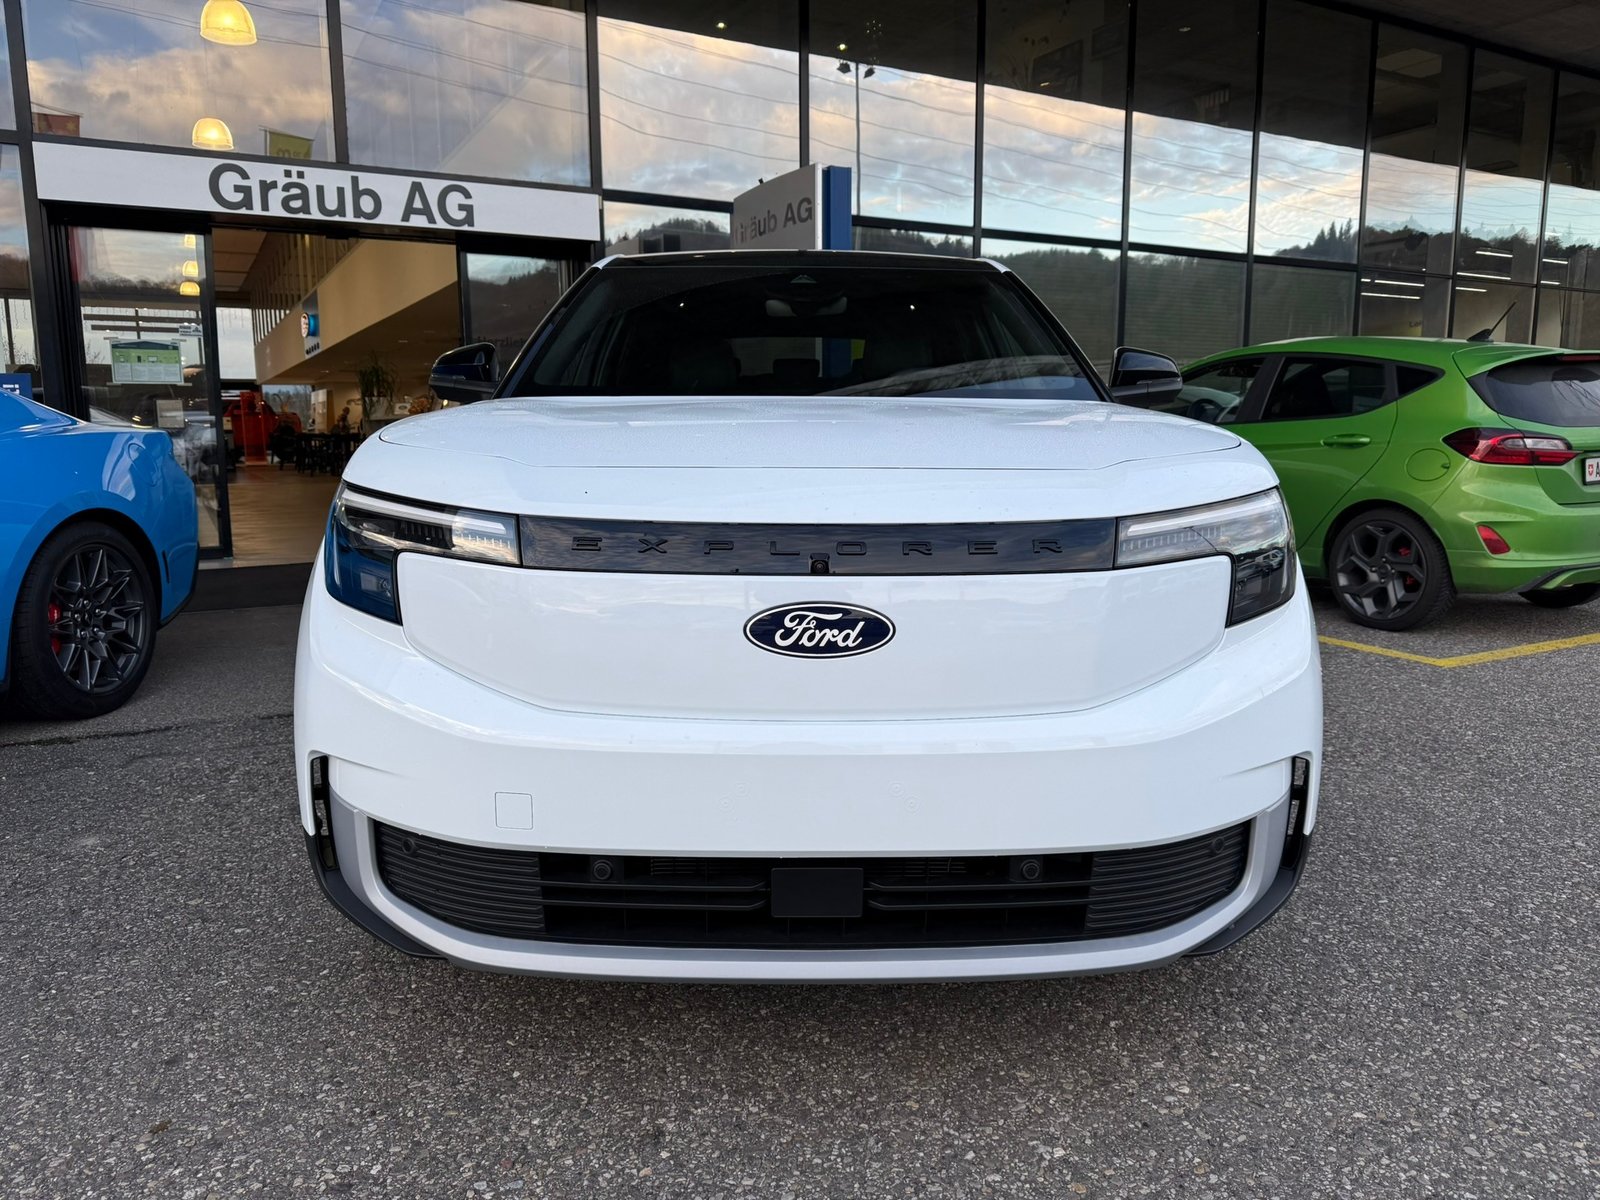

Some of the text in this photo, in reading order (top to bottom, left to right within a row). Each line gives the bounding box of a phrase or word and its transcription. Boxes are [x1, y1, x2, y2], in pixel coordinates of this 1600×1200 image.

[208, 162, 475, 228] Gräub AG
[783, 196, 813, 228] AG
[571, 536, 1064, 557] EXPLORER
[774, 611, 866, 648] Ford
